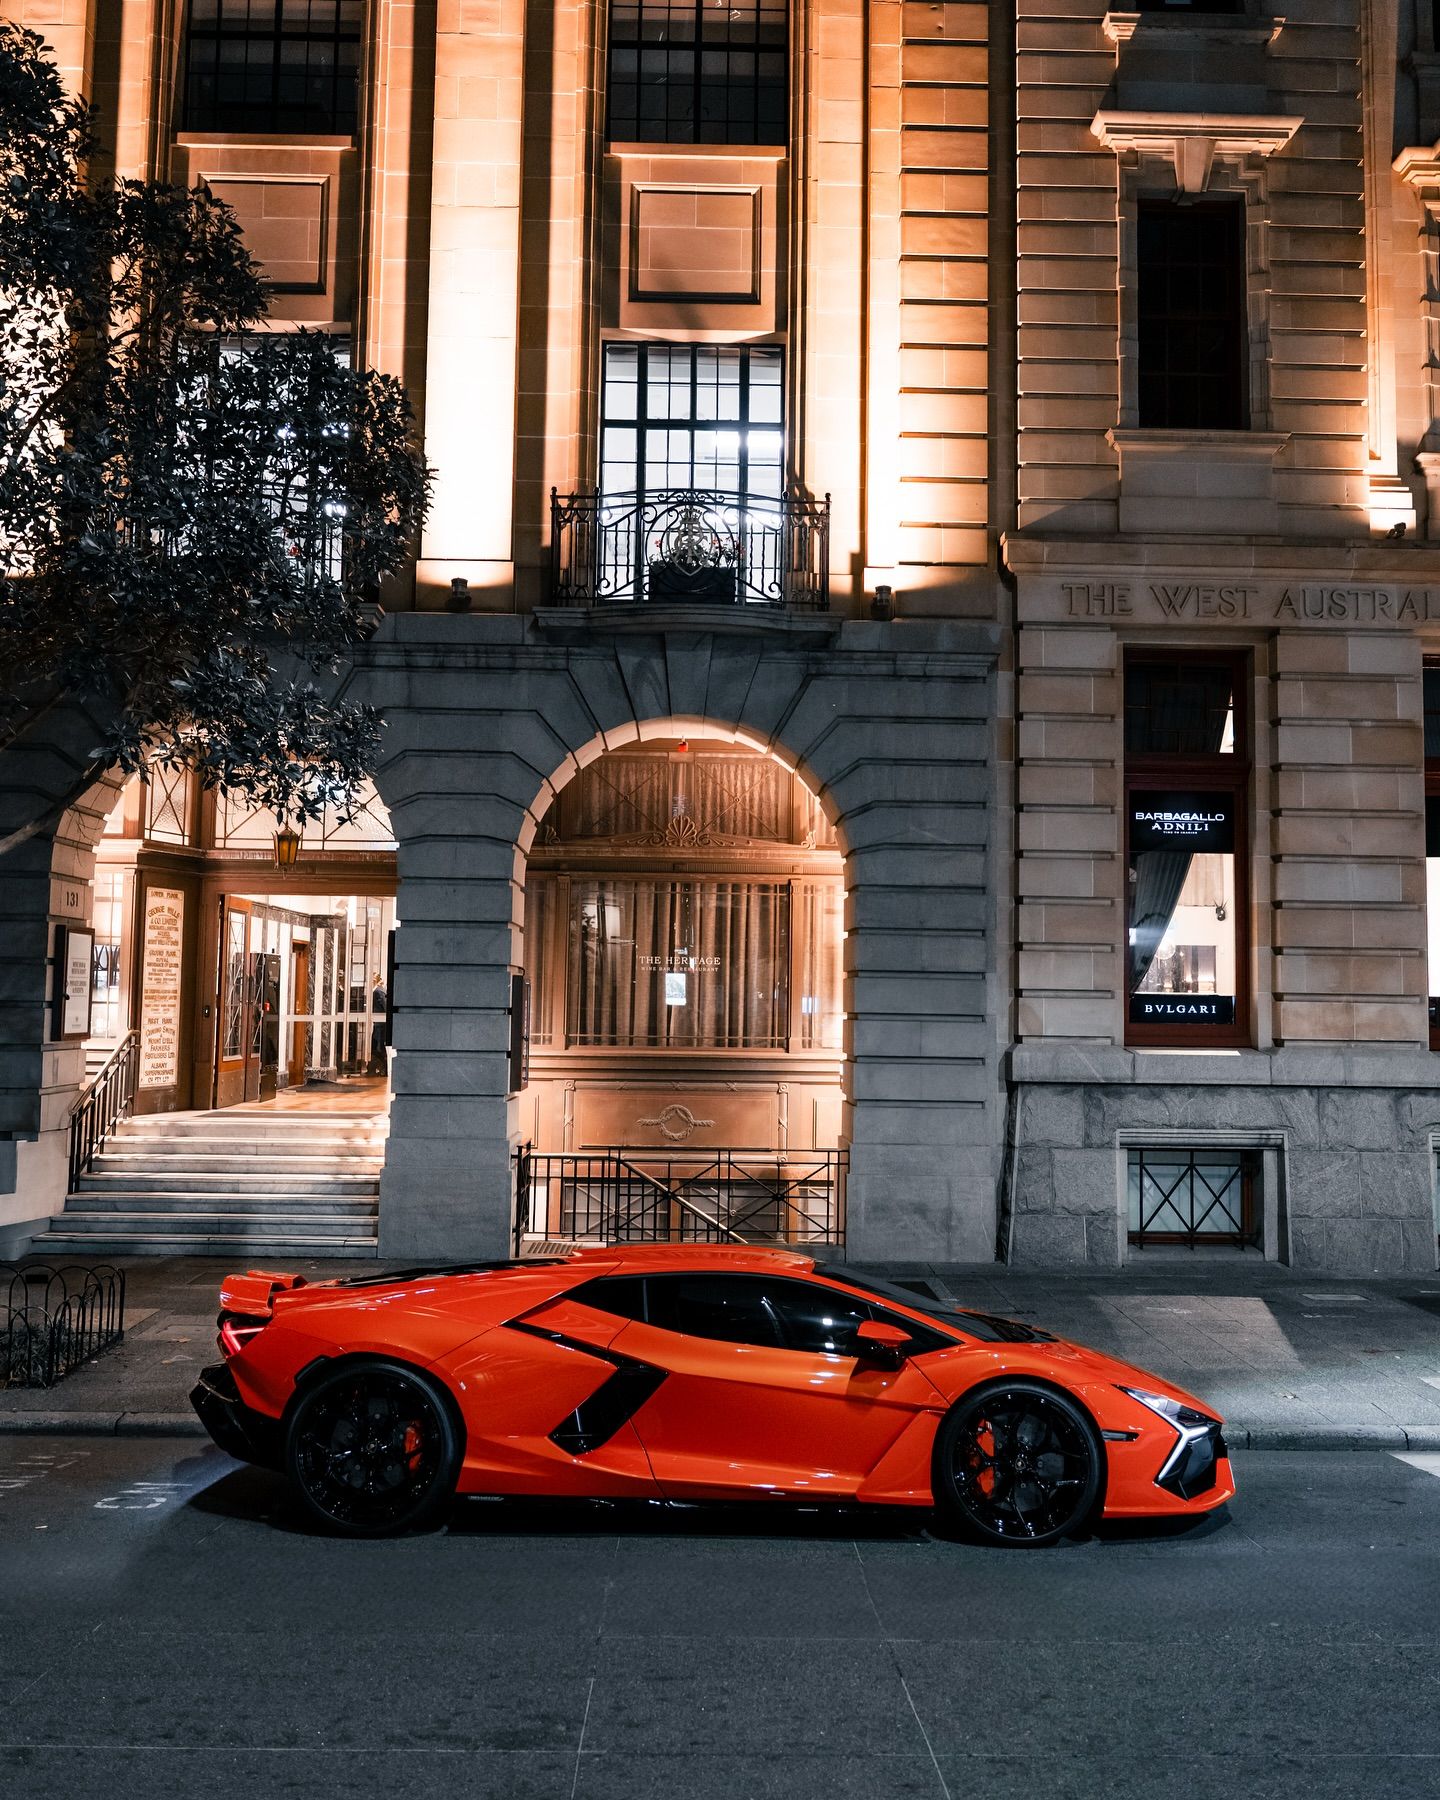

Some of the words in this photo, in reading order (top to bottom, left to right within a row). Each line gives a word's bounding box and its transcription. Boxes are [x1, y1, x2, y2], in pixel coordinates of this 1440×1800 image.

[1061, 583, 1135, 617] THE
[1149, 584, 1259, 619] WEST
[1273, 588, 1440, 621] AUSTRAL
[1135, 812, 1225, 821] BARBAGALLO
[1151, 823, 1209, 831] ADNILI
[66, 891, 79, 907] 131
[639, 956, 662, 965] THE
[1144, 1004, 1217, 1014] BVLGARI
